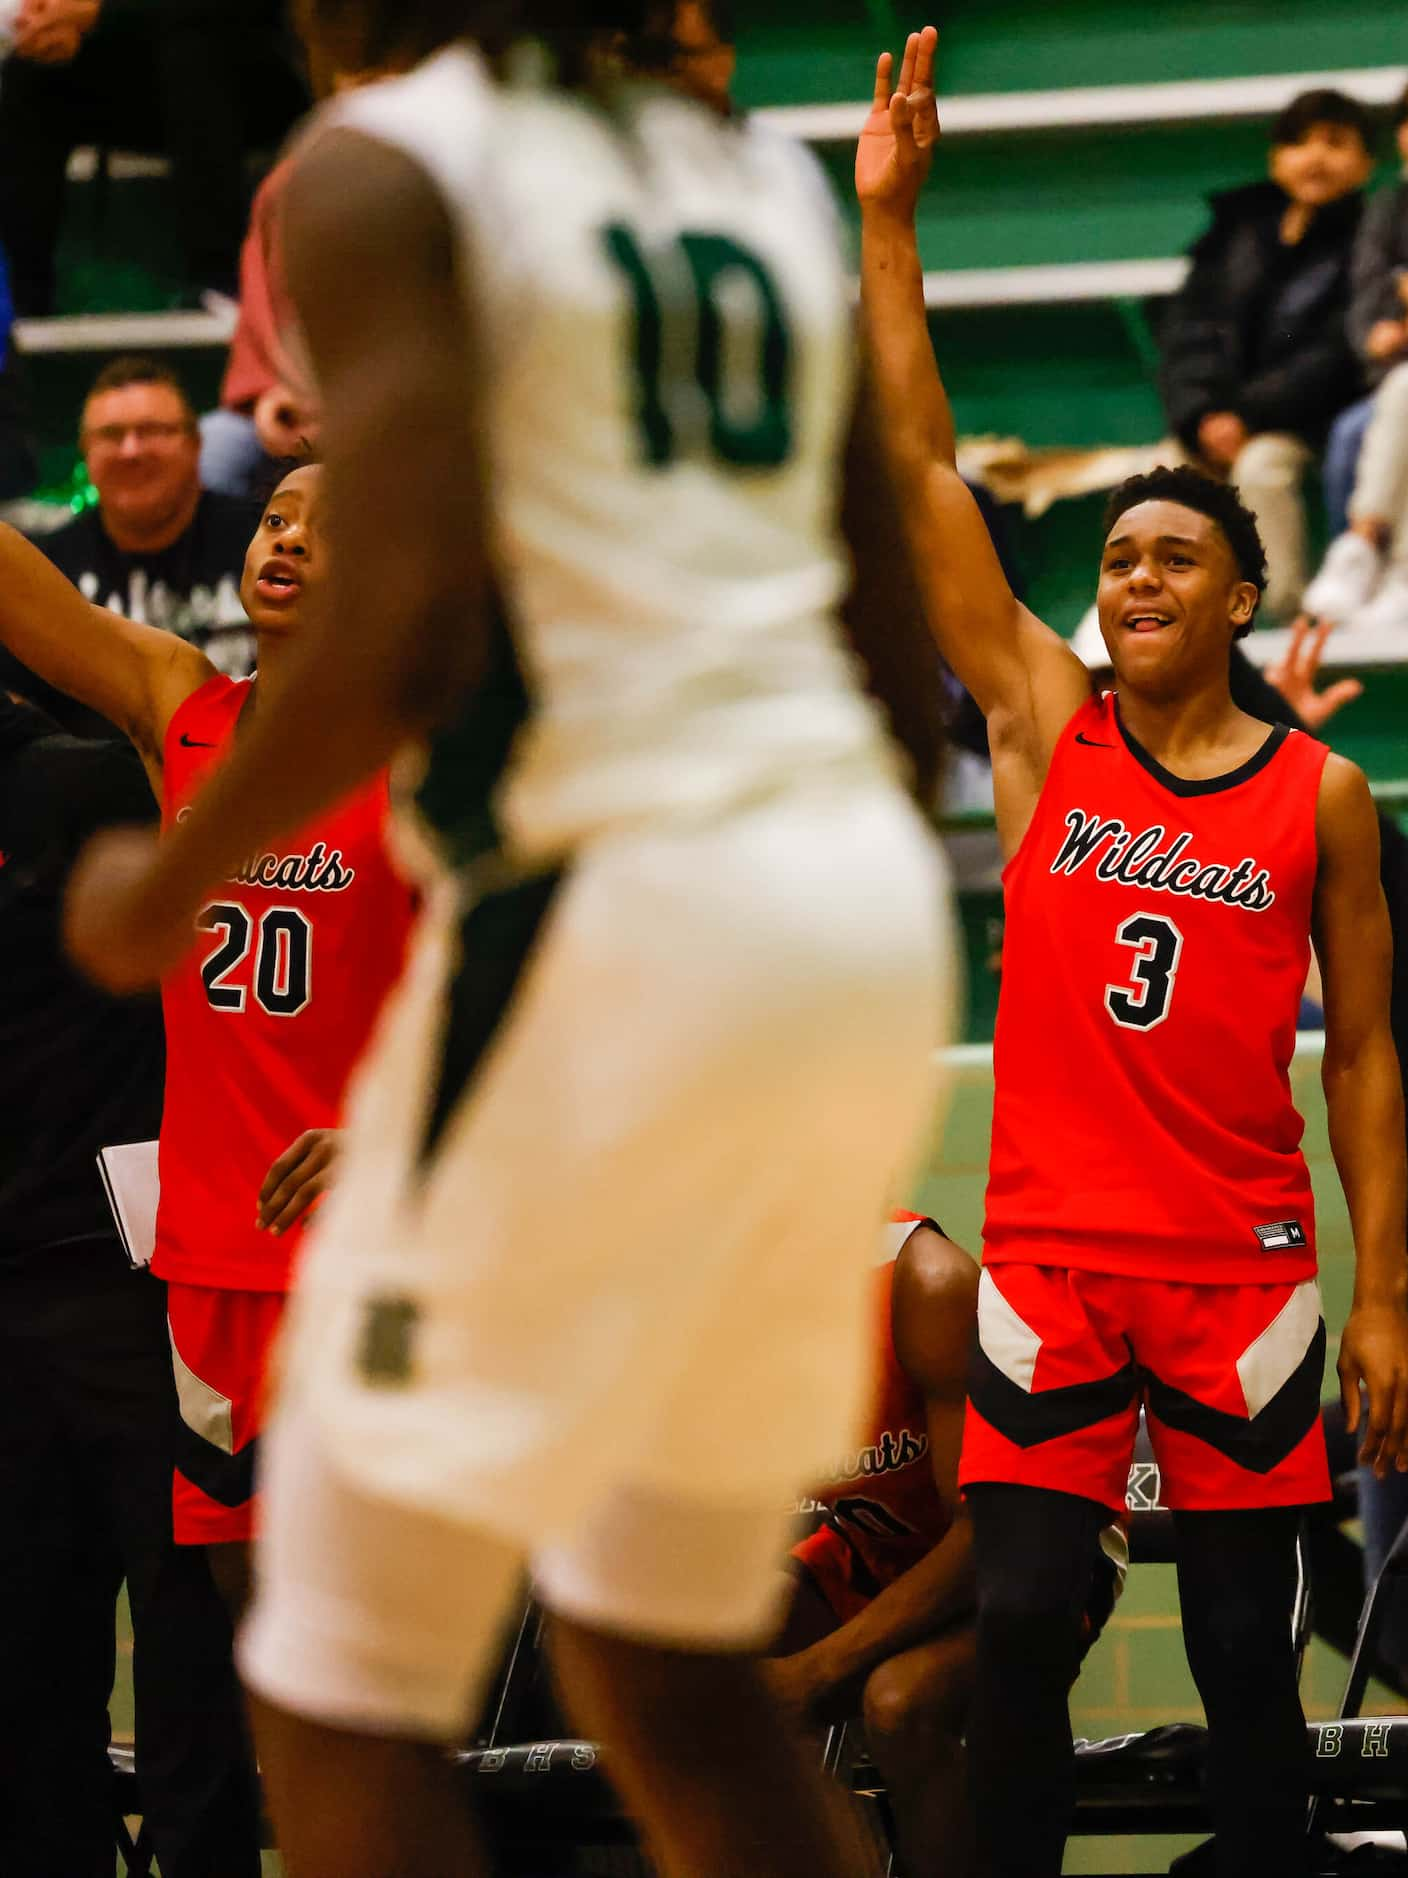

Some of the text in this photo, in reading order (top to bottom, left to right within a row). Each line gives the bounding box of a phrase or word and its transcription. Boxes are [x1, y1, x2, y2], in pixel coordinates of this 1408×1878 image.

[598, 220, 792, 470] 10
[1050, 808, 1275, 912] Wildcats
[195, 901, 313, 1017] 20
[1103, 911, 1184, 1033] 3
